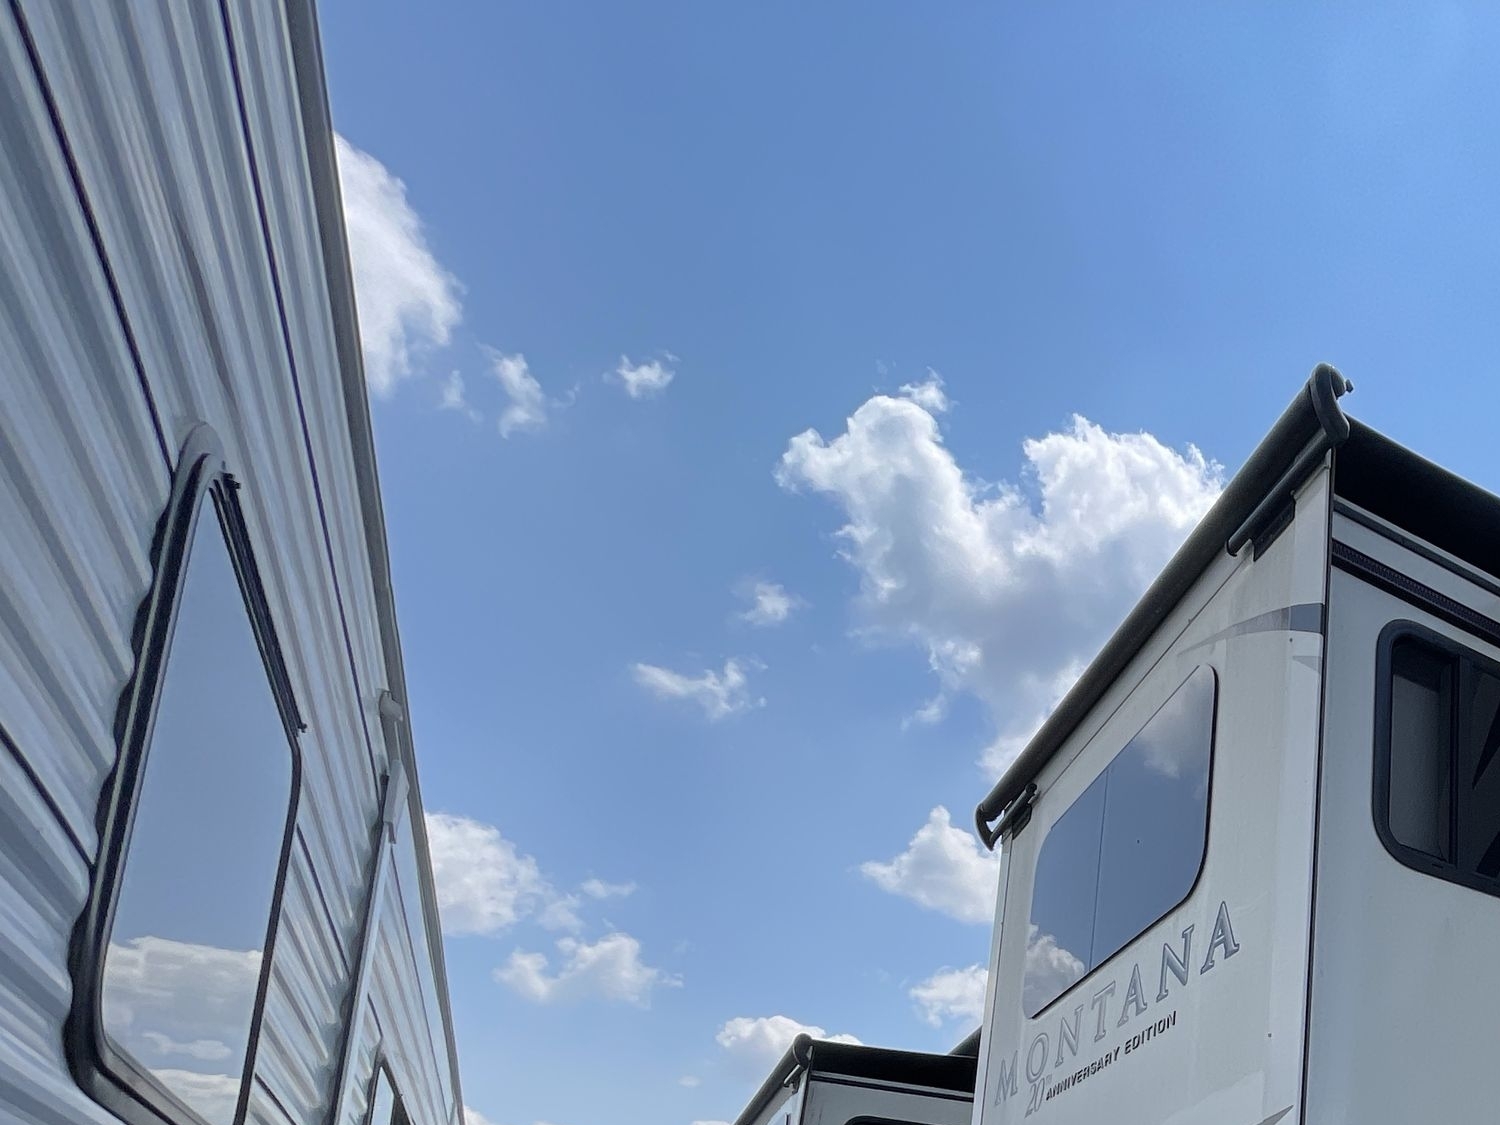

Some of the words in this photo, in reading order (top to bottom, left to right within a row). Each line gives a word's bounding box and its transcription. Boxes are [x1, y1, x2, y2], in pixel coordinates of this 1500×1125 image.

[995, 900, 1240, 1106] MONTANA
[1046, 1046, 1120, 1101] ANNIVERSARY
[1125, 1010, 1177, 1055] EDITION
